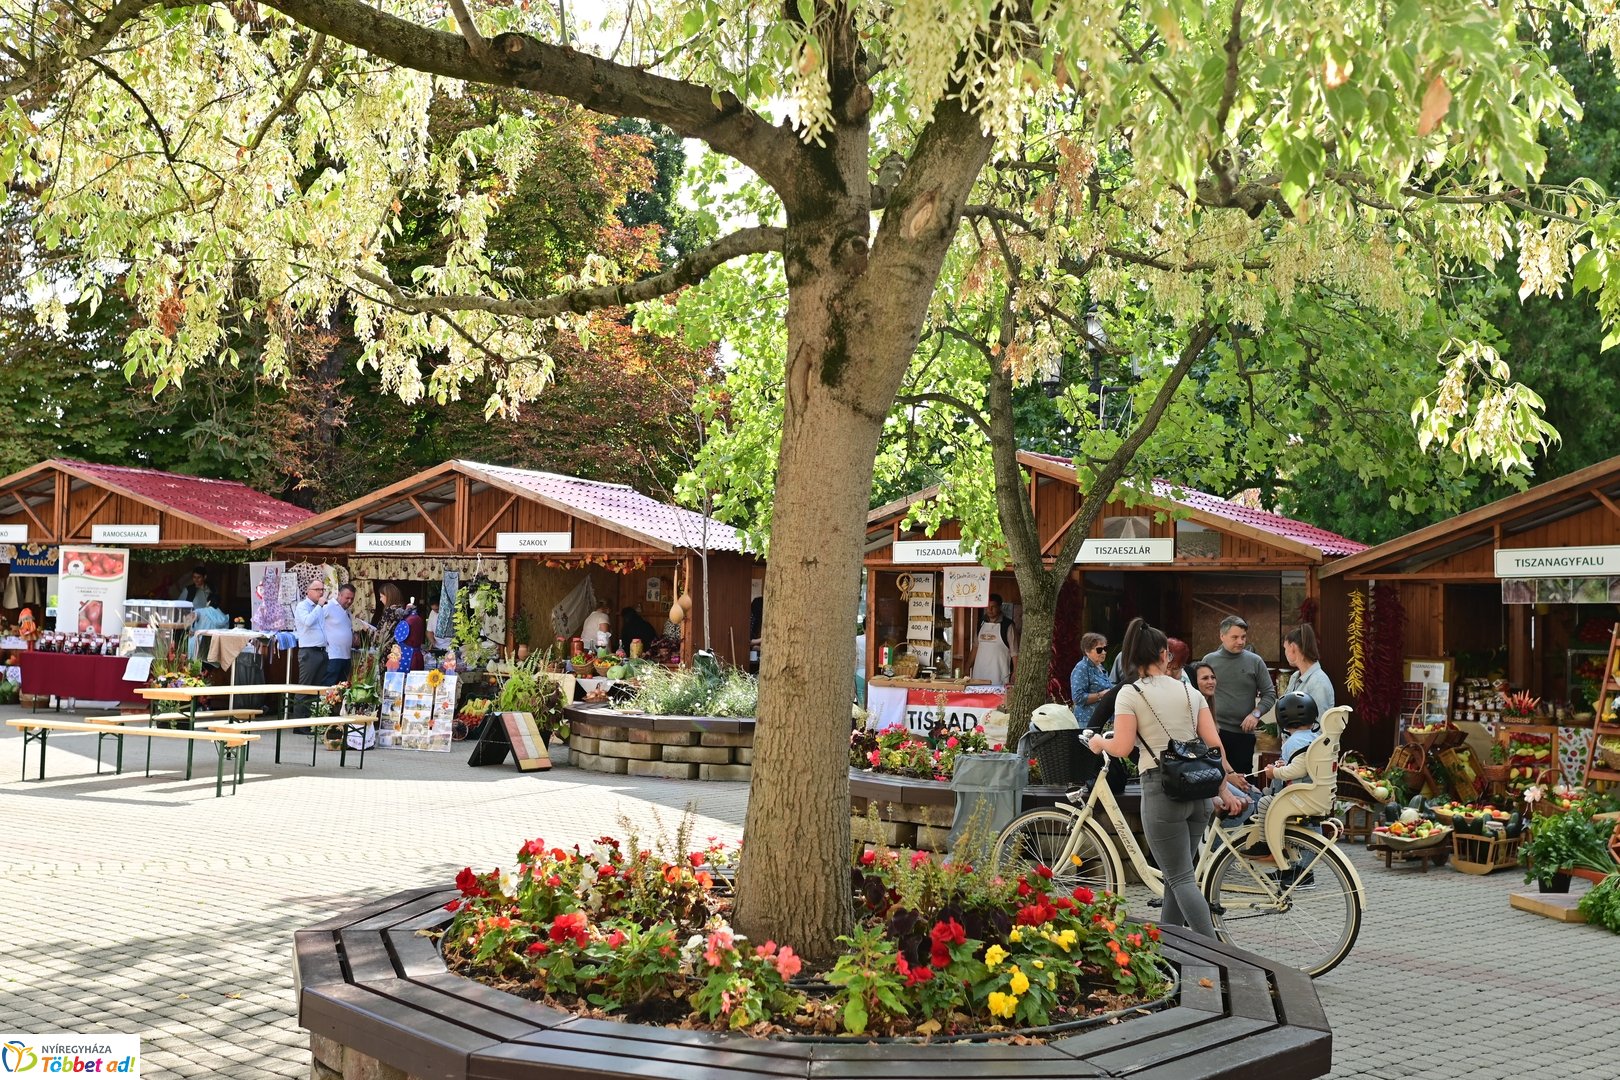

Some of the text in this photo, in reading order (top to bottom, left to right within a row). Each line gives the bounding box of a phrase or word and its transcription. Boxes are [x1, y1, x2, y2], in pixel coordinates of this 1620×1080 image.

[102, 530, 148, 538] RAMOCSAHÁZA
[368, 538, 412, 547] KÁLLÓSEMJÉN
[518, 539, 548, 547] SZAKOLY
[1094, 545, 1151, 555] TISZAESZLÁR
[1514, 556, 1605, 568] TISZANAGYFALU
